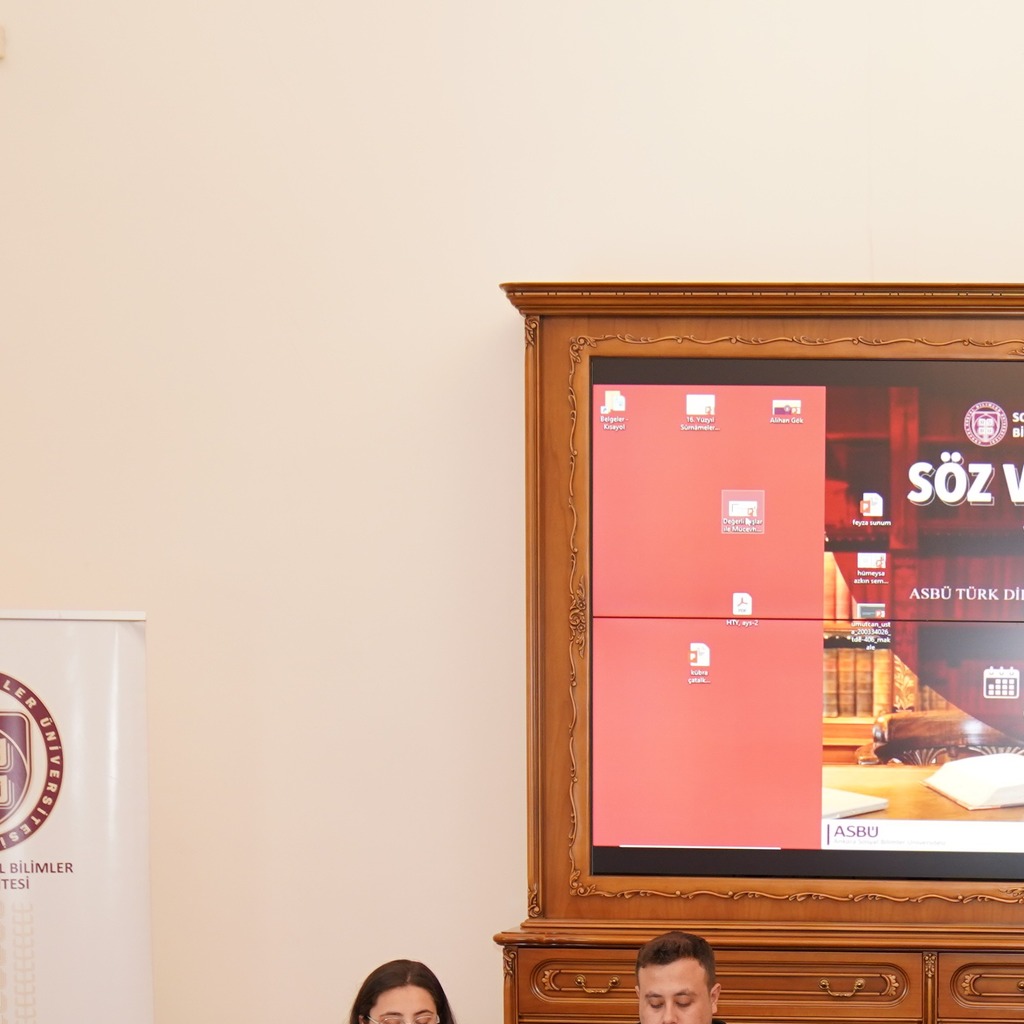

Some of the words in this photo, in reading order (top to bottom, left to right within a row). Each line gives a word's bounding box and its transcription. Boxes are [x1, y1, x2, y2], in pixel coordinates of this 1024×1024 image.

[907, 451, 994, 506] SÖZ
[909, 585, 951, 600] ASBÜ
[956, 586, 999, 600] TÜRK
[834, 825, 879, 839] ASBÜ
[10, 859, 74, 874] BİLİMLER
[0, 875, 30, 890] TESİ
